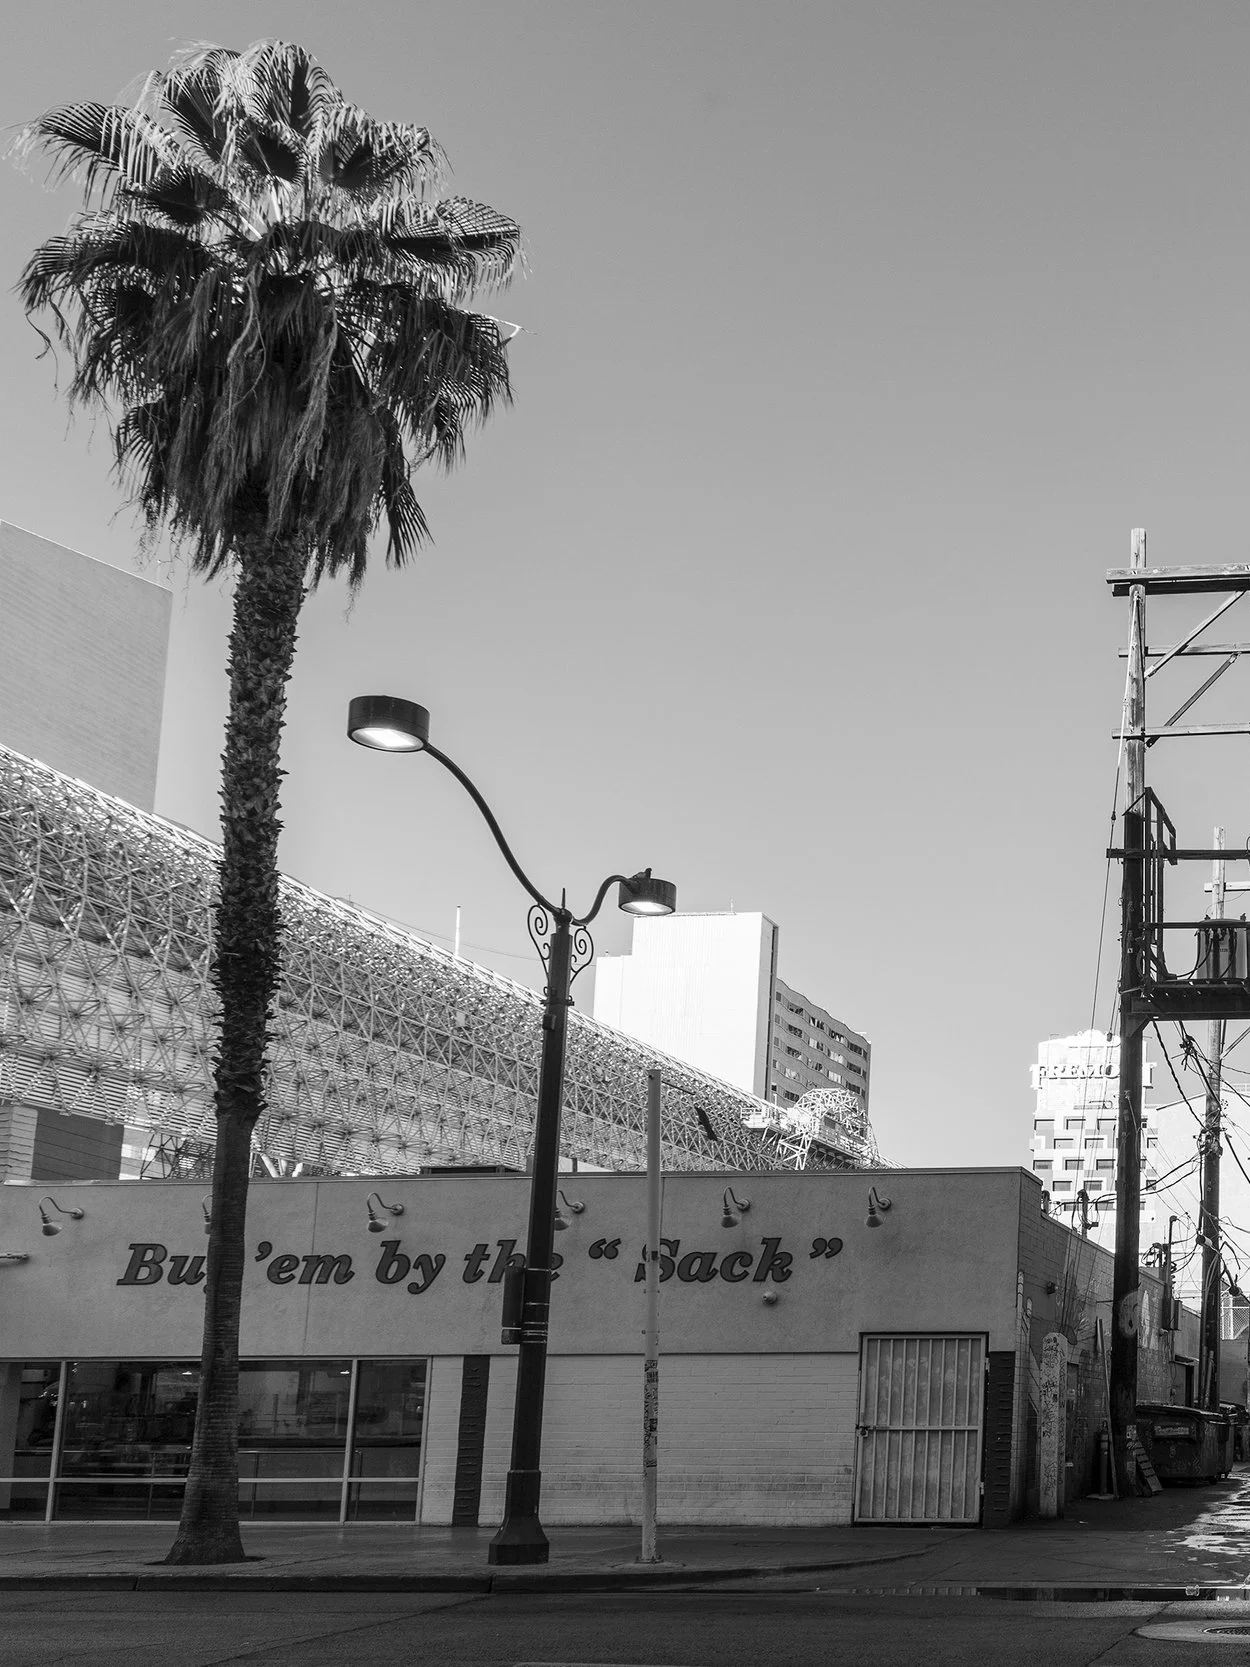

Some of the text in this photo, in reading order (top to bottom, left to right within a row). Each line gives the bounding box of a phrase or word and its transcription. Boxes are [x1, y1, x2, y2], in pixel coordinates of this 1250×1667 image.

[1029, 1062, 1157, 1090] FREMOT
[116, 1242, 208, 1295] Bu
[374, 1239, 447, 1296] by
